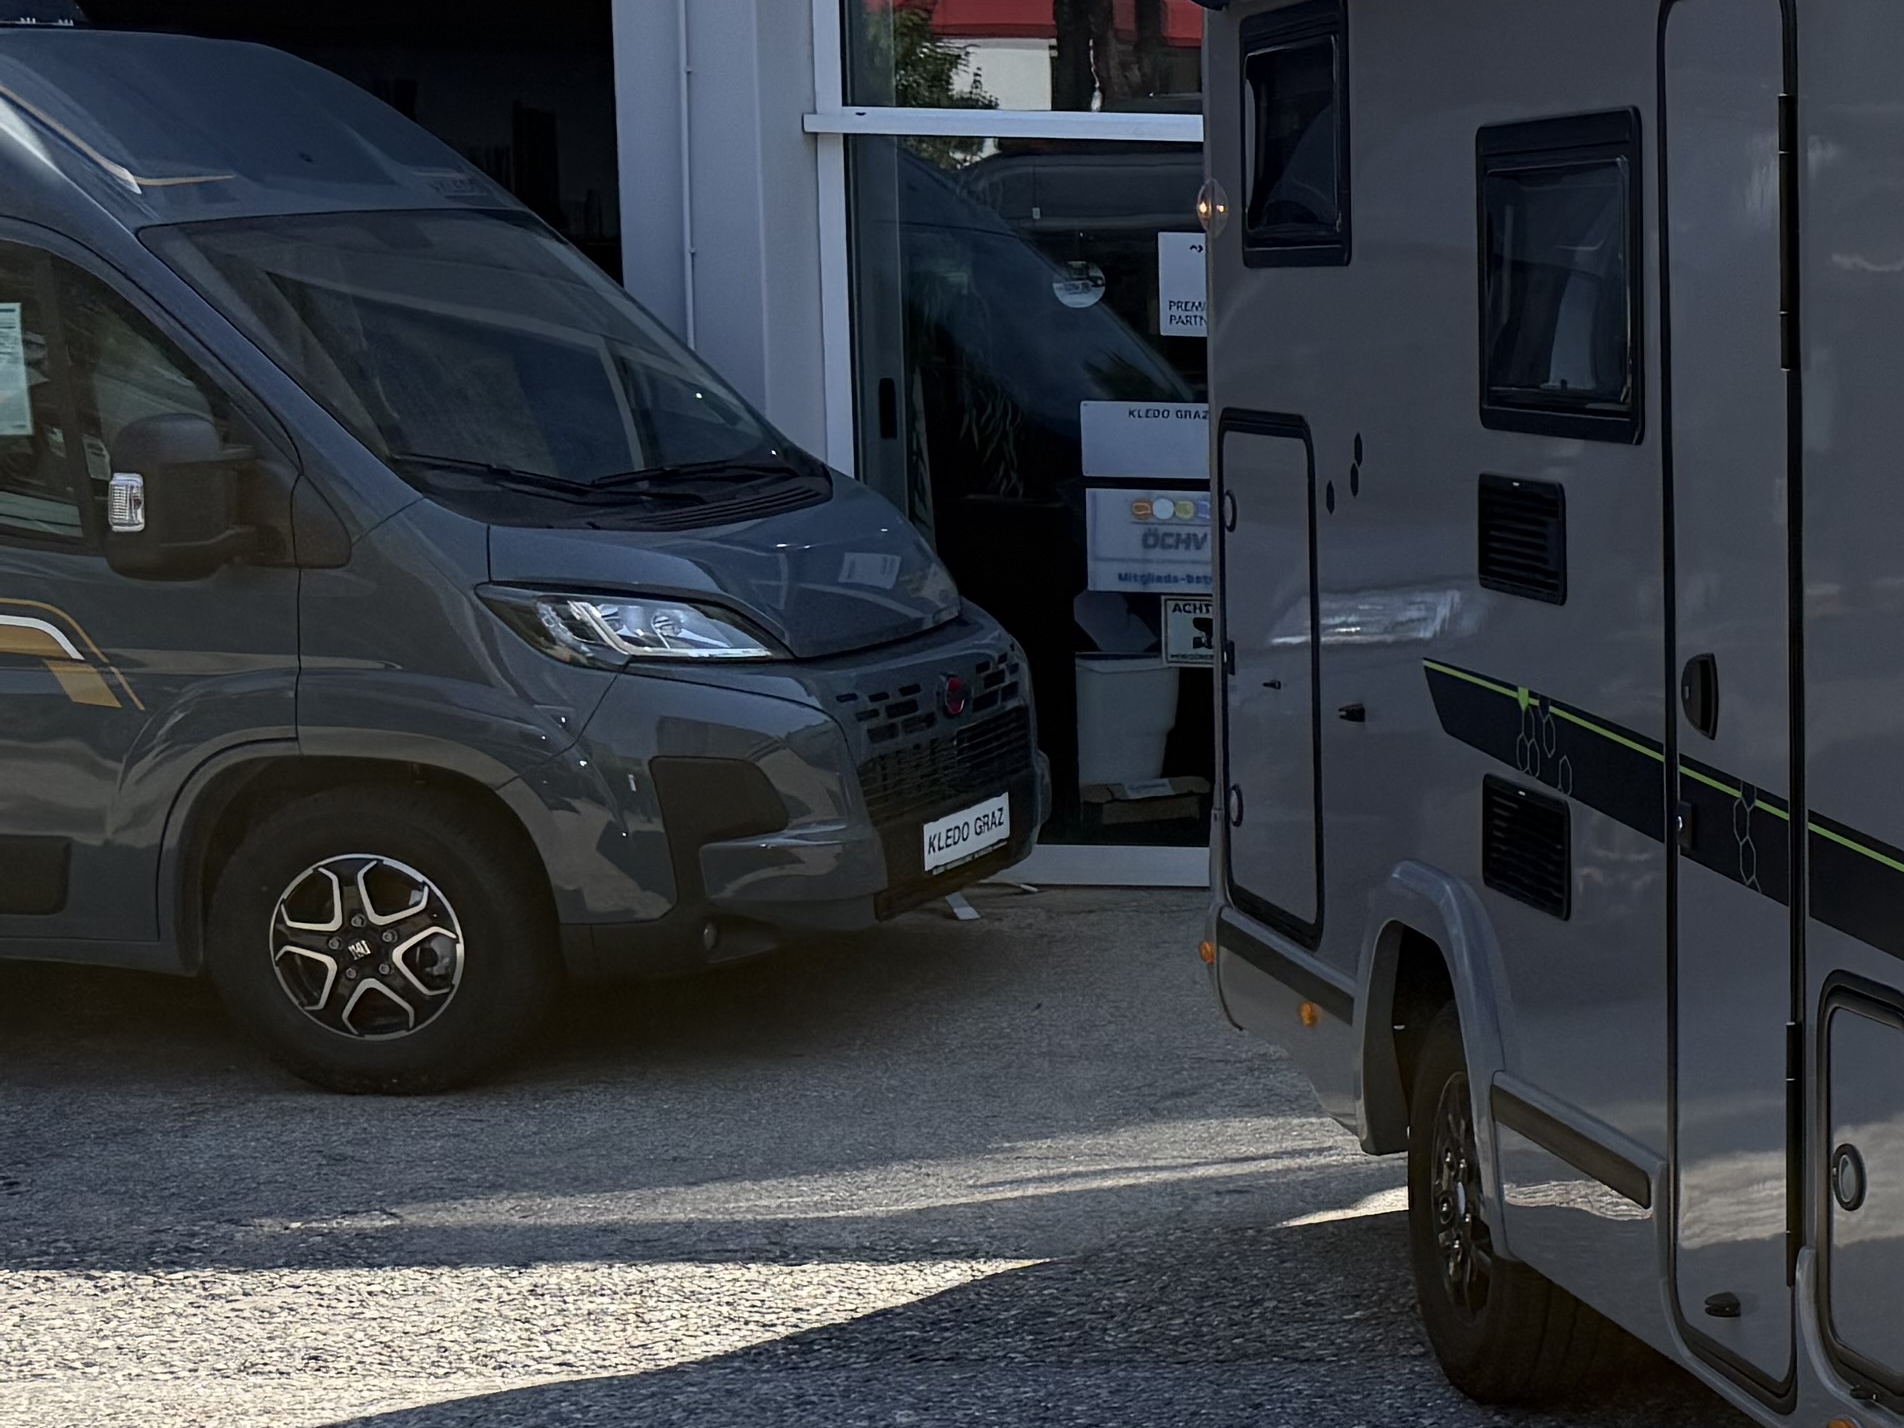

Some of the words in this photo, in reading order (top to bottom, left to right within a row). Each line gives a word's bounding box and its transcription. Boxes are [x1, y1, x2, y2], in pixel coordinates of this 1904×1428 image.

[1128, 407, 1171, 419] KLEDO
[1175, 409, 1209, 420] GRAZ
[927, 821, 970, 855] KLEDO
[974, 807, 1004, 836] GRAZ
